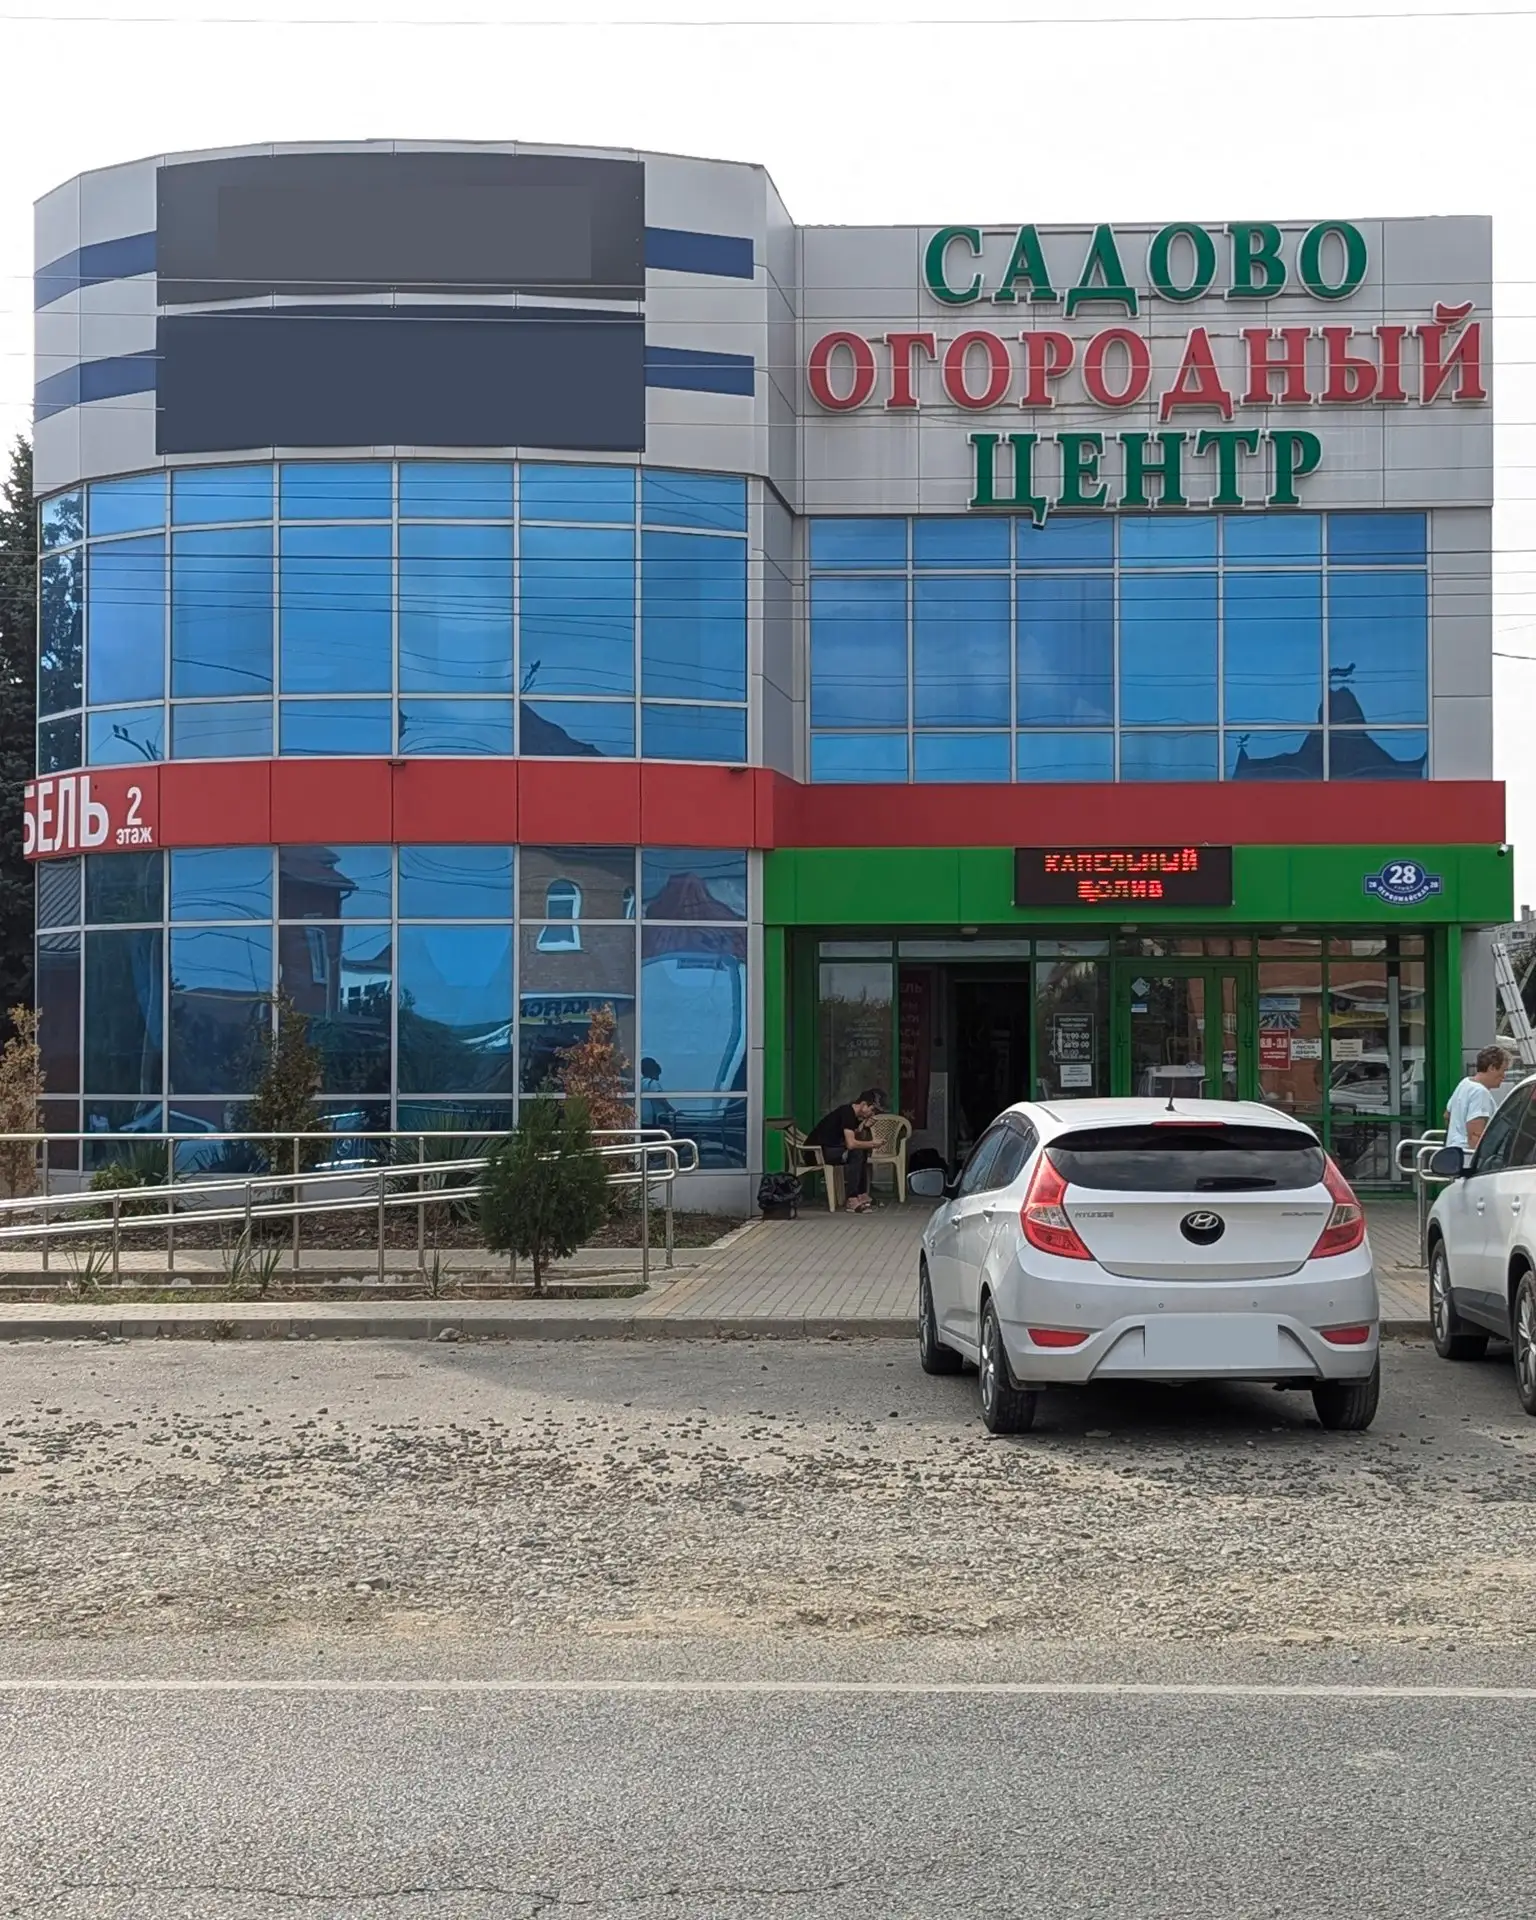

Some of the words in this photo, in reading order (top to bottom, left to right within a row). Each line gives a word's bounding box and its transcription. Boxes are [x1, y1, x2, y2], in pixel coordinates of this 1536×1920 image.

[922, 219, 1368, 320] САДОВО
[808, 301, 1487, 422] ОГОРОДНЫЙ
[967, 429, 1322, 530] ЦЕНТР
[116, 826, 152, 845] этаж
[127, 786, 142, 826] 2
[1389, 865, 1416, 884] 28
